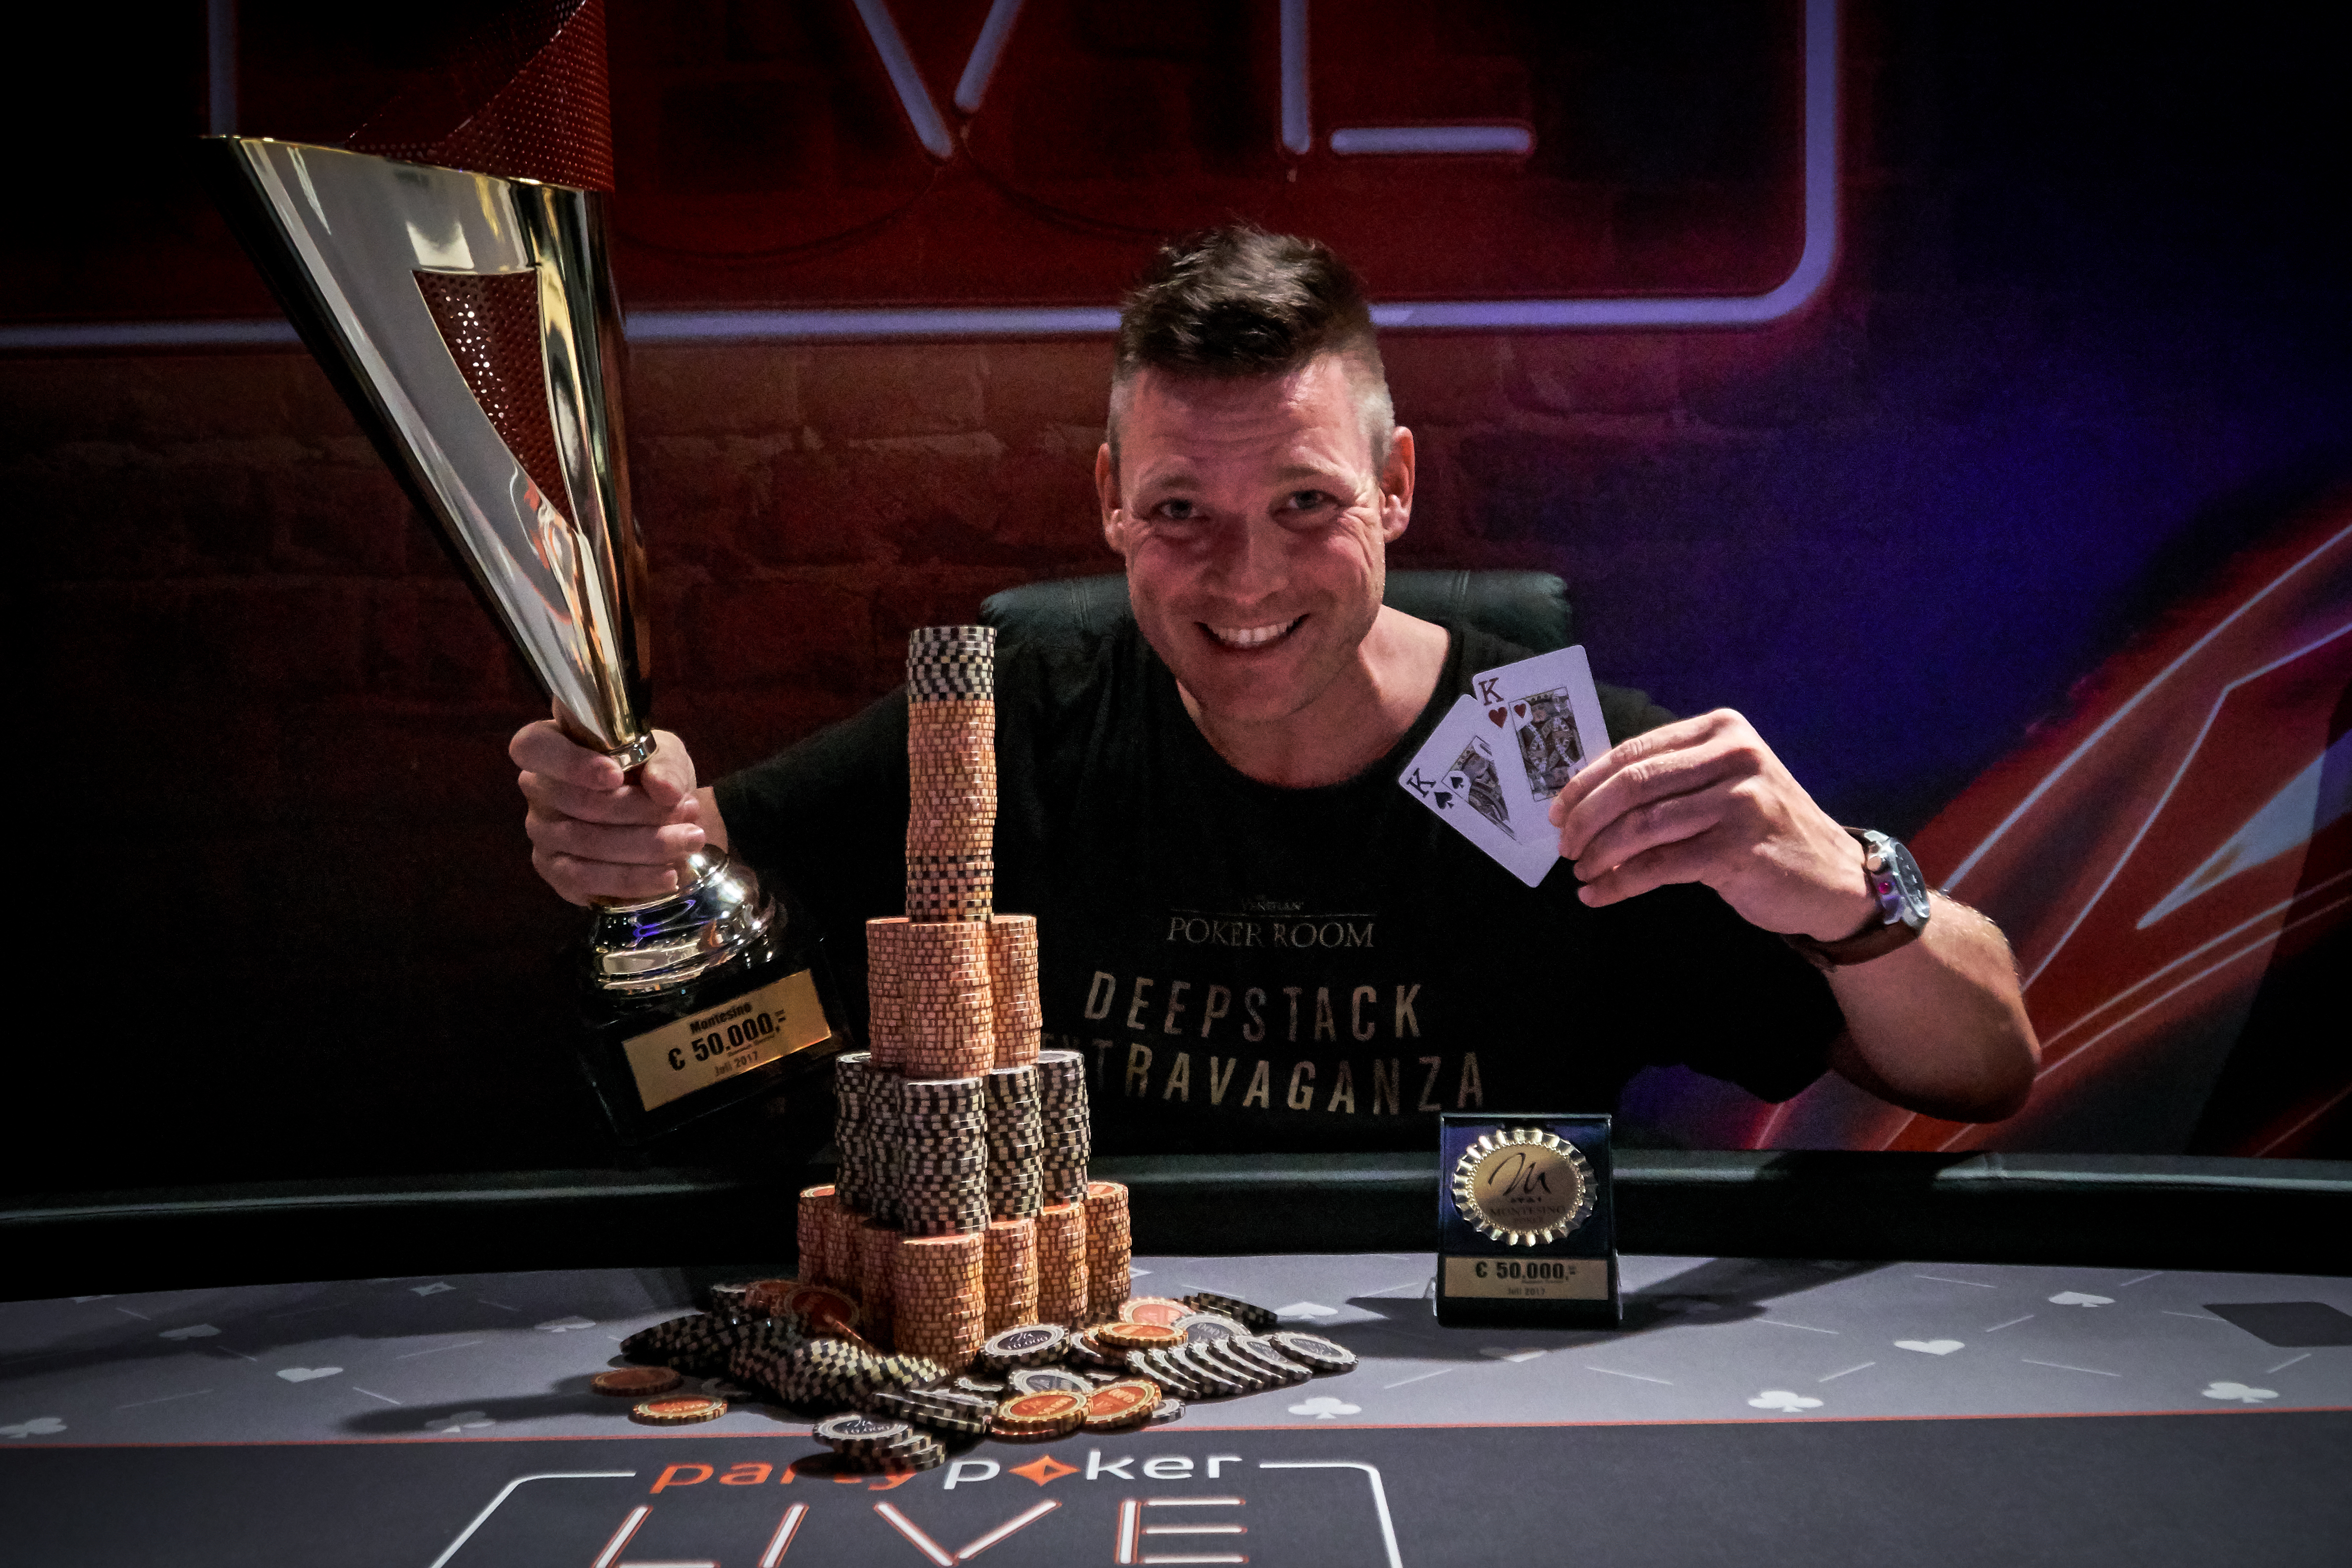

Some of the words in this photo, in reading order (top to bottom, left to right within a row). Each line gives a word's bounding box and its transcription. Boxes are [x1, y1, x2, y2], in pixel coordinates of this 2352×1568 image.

[1478, 677, 1504, 706] K
[1407, 768, 1436, 798] K
[1166, 916, 1265, 948] POKER
[1273, 920, 1375, 948] ROOM
[690, 1002, 752, 1035] Montesino
[1085, 970, 1424, 1043] DEEPSTACK
[734, 1050, 758, 1068] 2017
[1040, 1031, 1485, 1116] TRAVAGANZA
[591, 1498, 1250, 1568] LIVE
